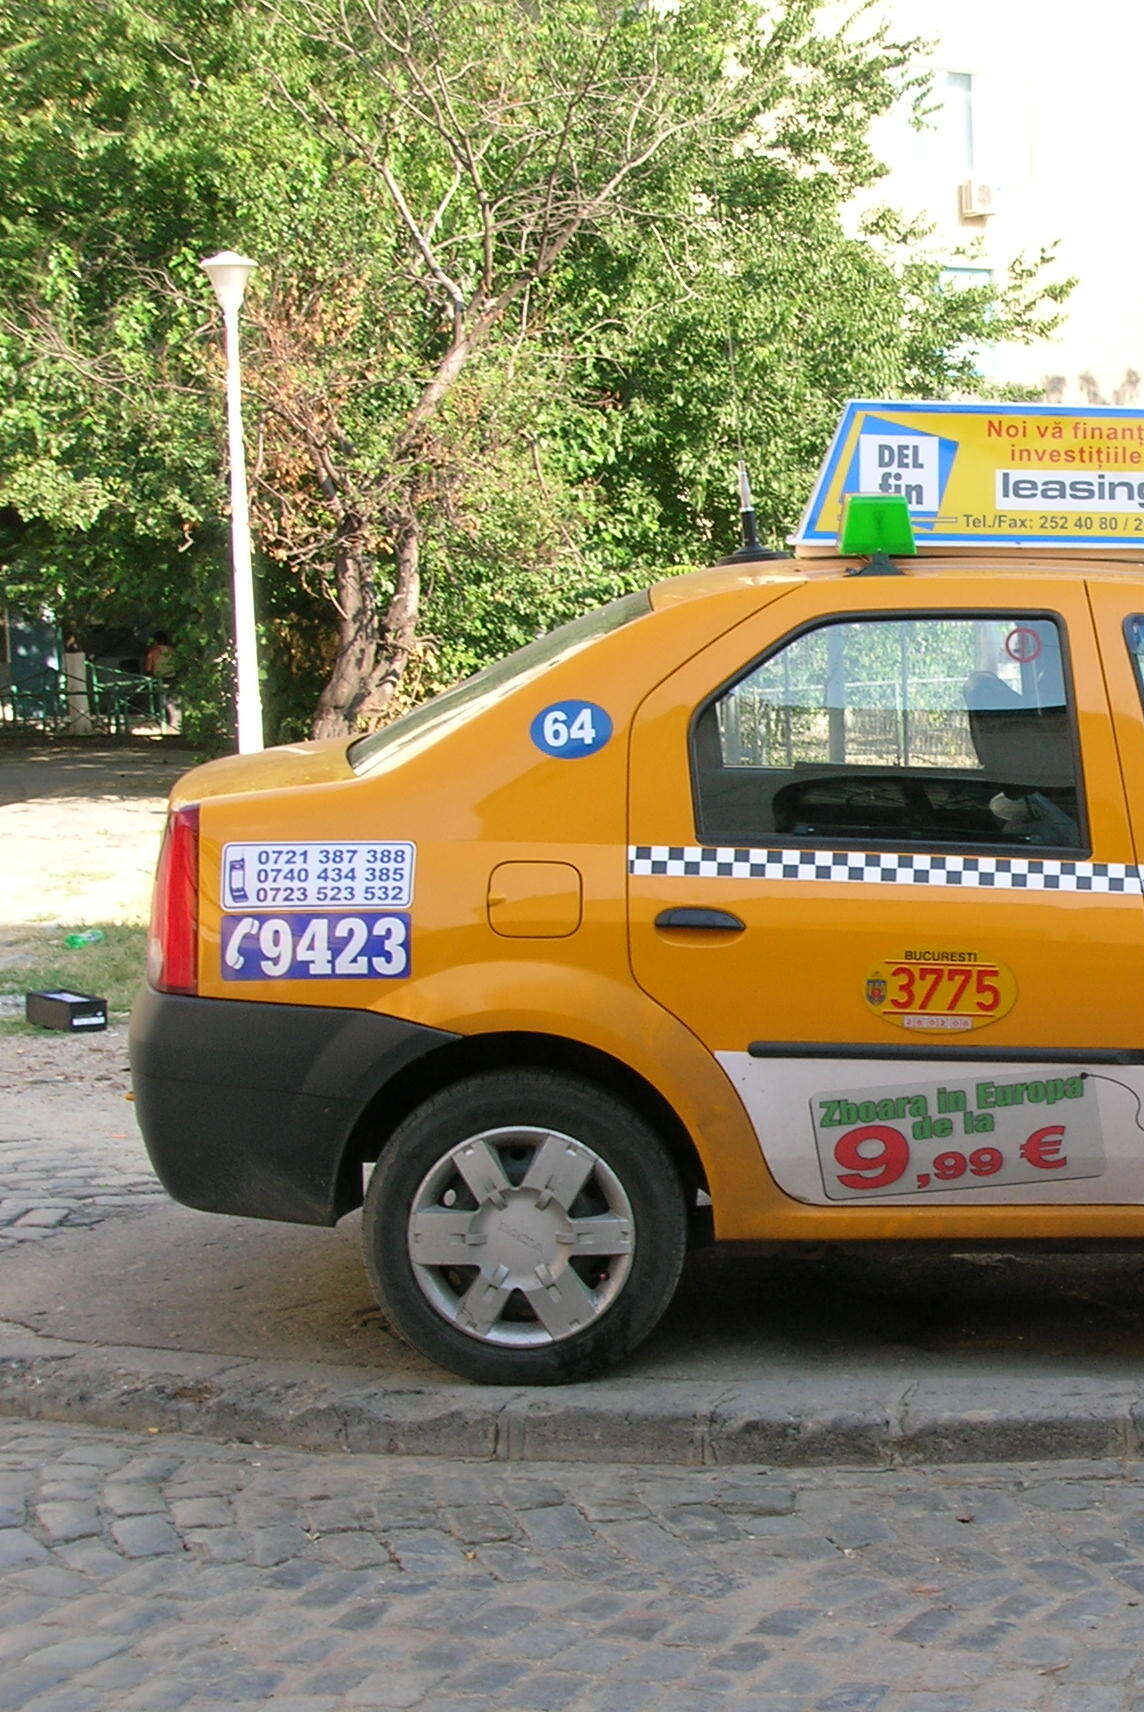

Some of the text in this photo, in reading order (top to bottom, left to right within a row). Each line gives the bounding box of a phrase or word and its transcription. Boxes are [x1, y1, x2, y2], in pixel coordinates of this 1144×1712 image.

[987, 420, 1027, 438] Noi
[1037, 421, 1064, 440] vă
[878, 444, 924, 469] DEL
[1010, 444, 1142, 469] investițiile
[879, 471, 924, 506] fin
[963, 514, 1033, 530] Tel./Fax:
[1039, 516, 1068, 530] 252
[1074, 516, 1093, 530] 40
[1099, 516, 1118, 531] 80
[543, 708, 597, 747] 64
[258, 850, 406, 865] 0721 387 388
[257, 868, 405, 883] 0740 434 385
[256, 886, 403, 902] 0723 523 532
[259, 916, 407, 977] 9423
[904, 950, 978, 962] BUCURESTI
[890, 966, 1001, 1012] 3775
[819, 1076, 1084, 1128] Zboara in Europa
[912, 1111, 995, 1141] de la
[834, 1125, 1003, 1190] 9,99
